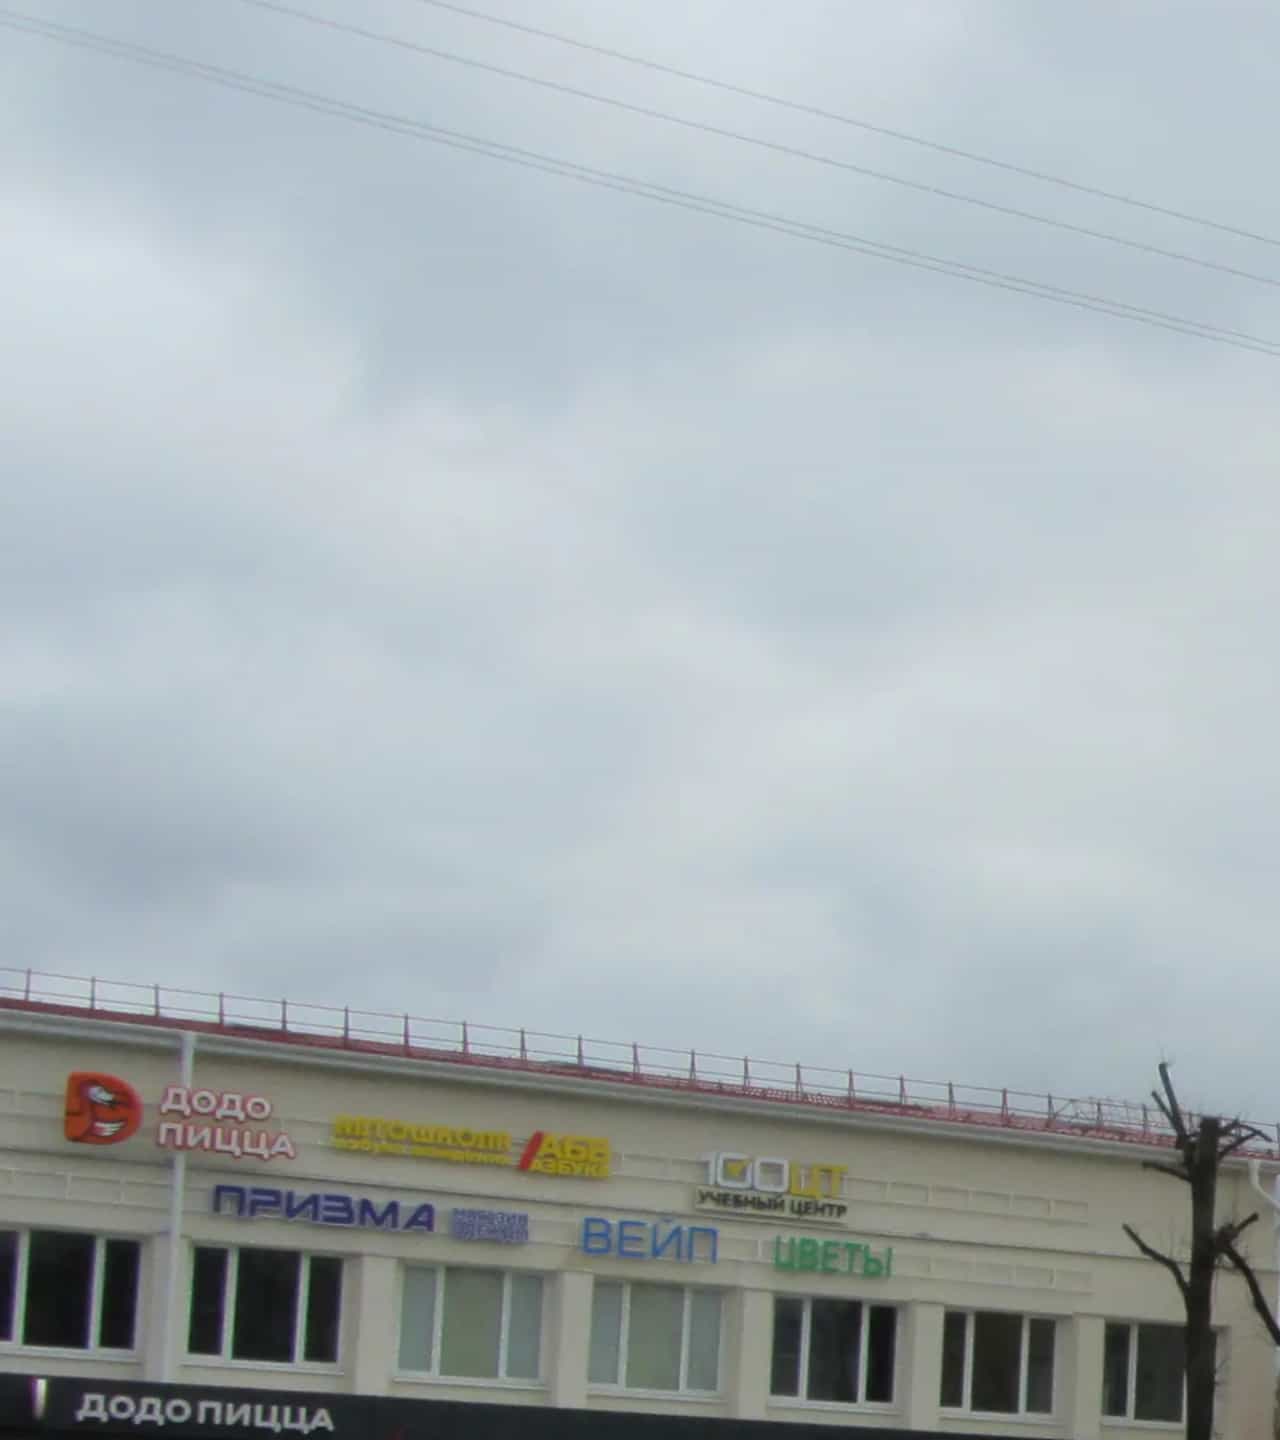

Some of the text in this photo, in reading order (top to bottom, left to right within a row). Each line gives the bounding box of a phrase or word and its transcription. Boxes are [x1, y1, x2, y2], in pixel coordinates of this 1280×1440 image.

[160, 1087, 273, 1121] ДОДО
[157, 1122, 296, 1161] ПИЦЦА
[213, 1183, 435, 1233] ПРИЗМА
[698, 1188, 848, 1219] УЧЕБНЫЙ ЦЕНТР
[582, 1216, 719, 1264] ВЕЙП
[774, 1234, 894, 1279] ЦВЕТЫ
[76, 1392, 335, 1434] ДОДО ПИЦЦА
